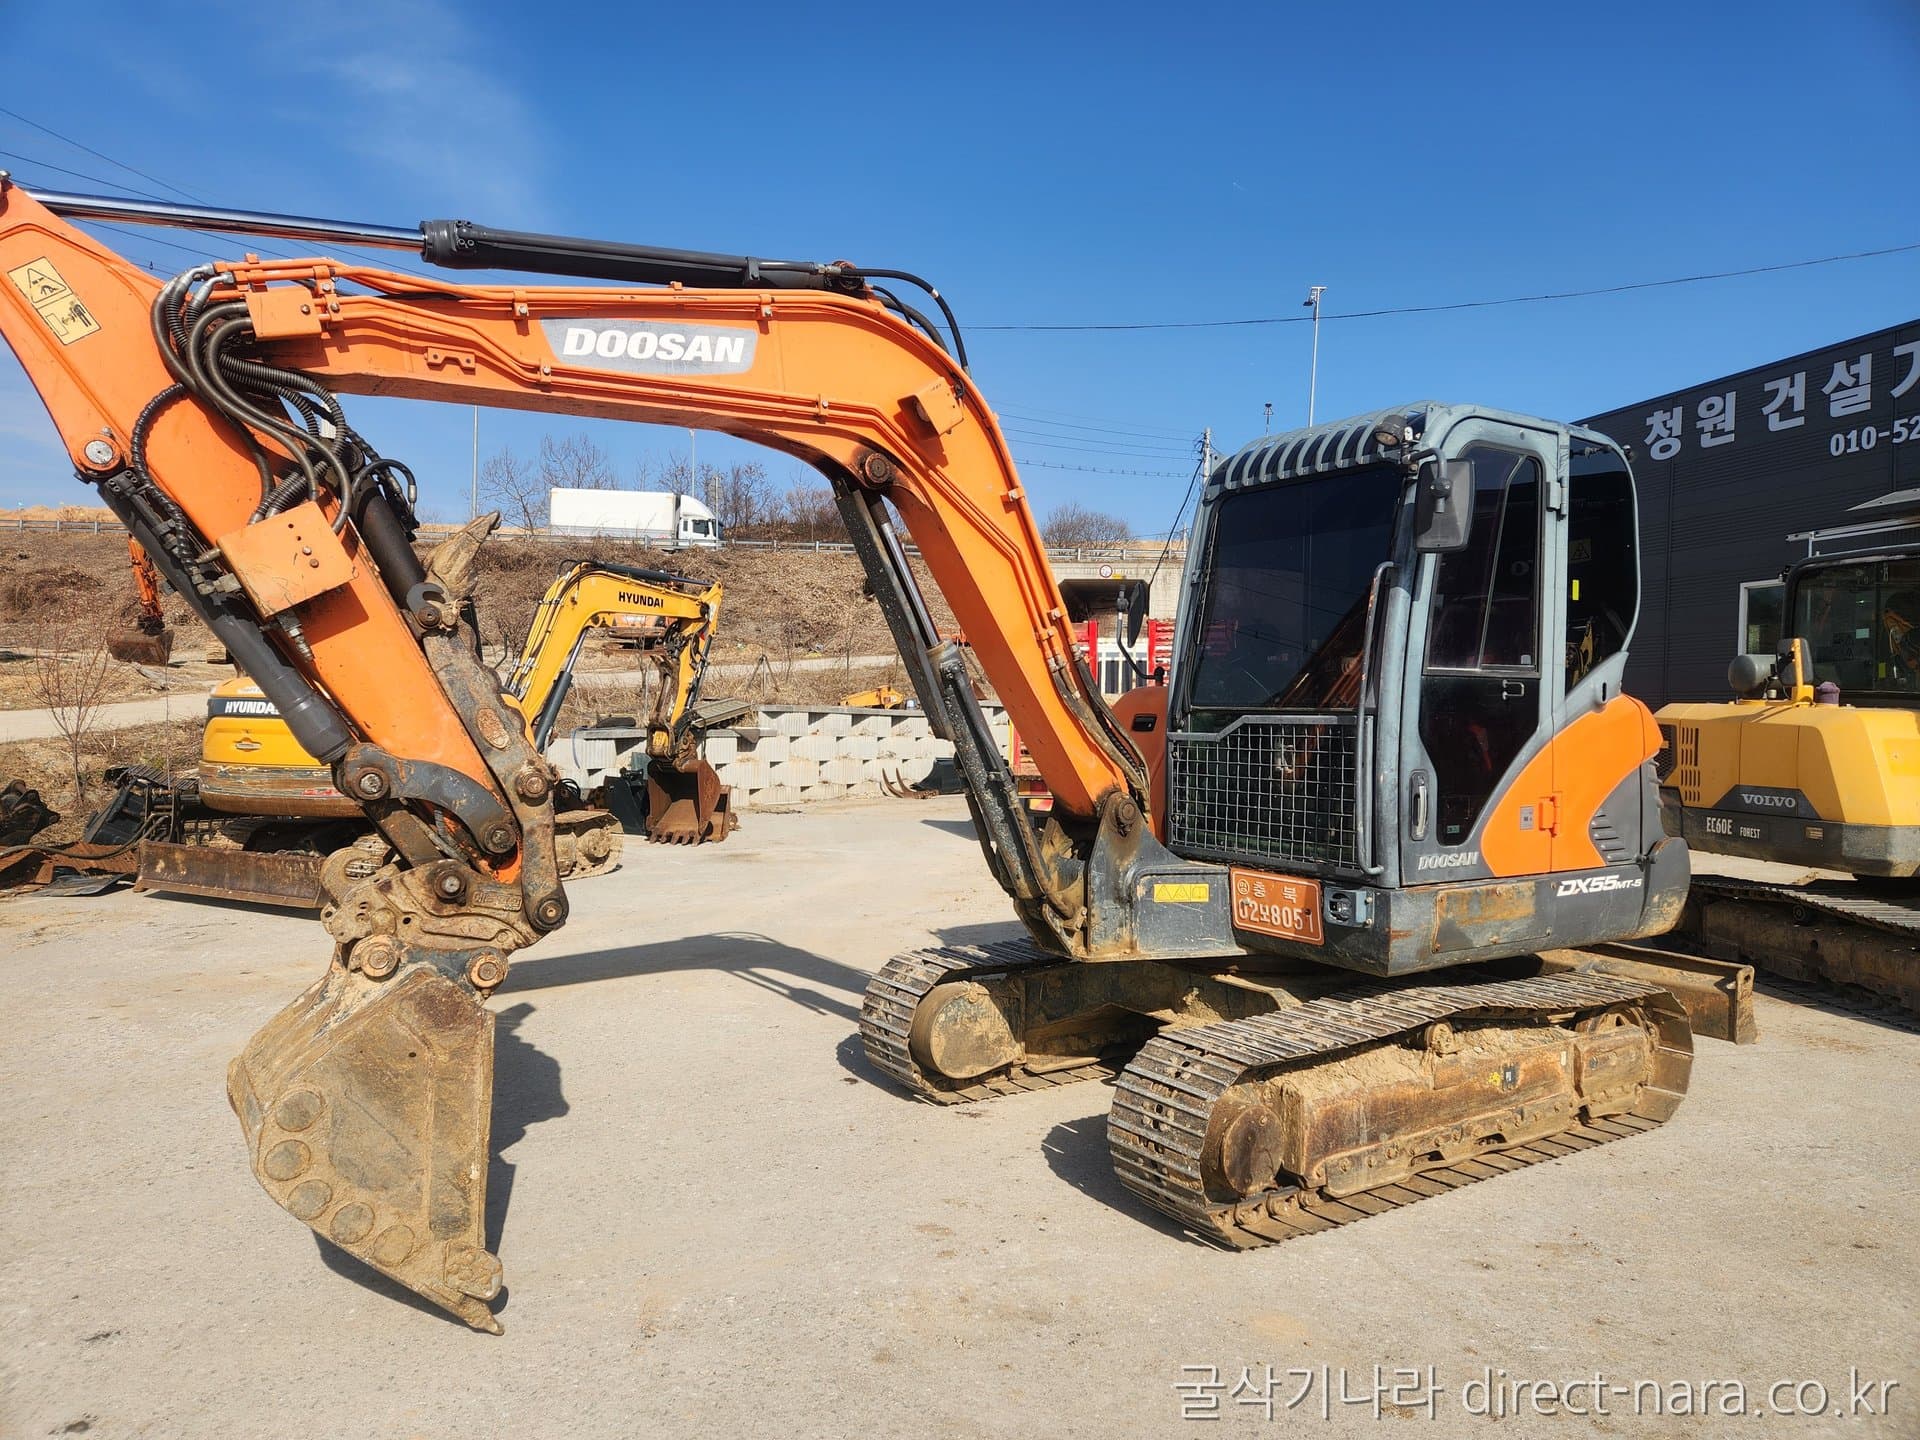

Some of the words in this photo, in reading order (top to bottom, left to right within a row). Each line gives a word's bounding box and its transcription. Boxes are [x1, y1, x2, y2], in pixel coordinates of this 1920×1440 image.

[563, 328, 745, 363] DOOSAN
[1644, 391, 1737, 461] 청원
[618, 591, 664, 609] HYUNDAI
[224, 701, 280, 715] HYUNDA
[1741, 793, 1796, 808] VOLVO
[1706, 816, 1733, 835] EC60E
[1739, 826, 1761, 839] FOREST
[1417, 851, 1480, 871] DOOSAN
